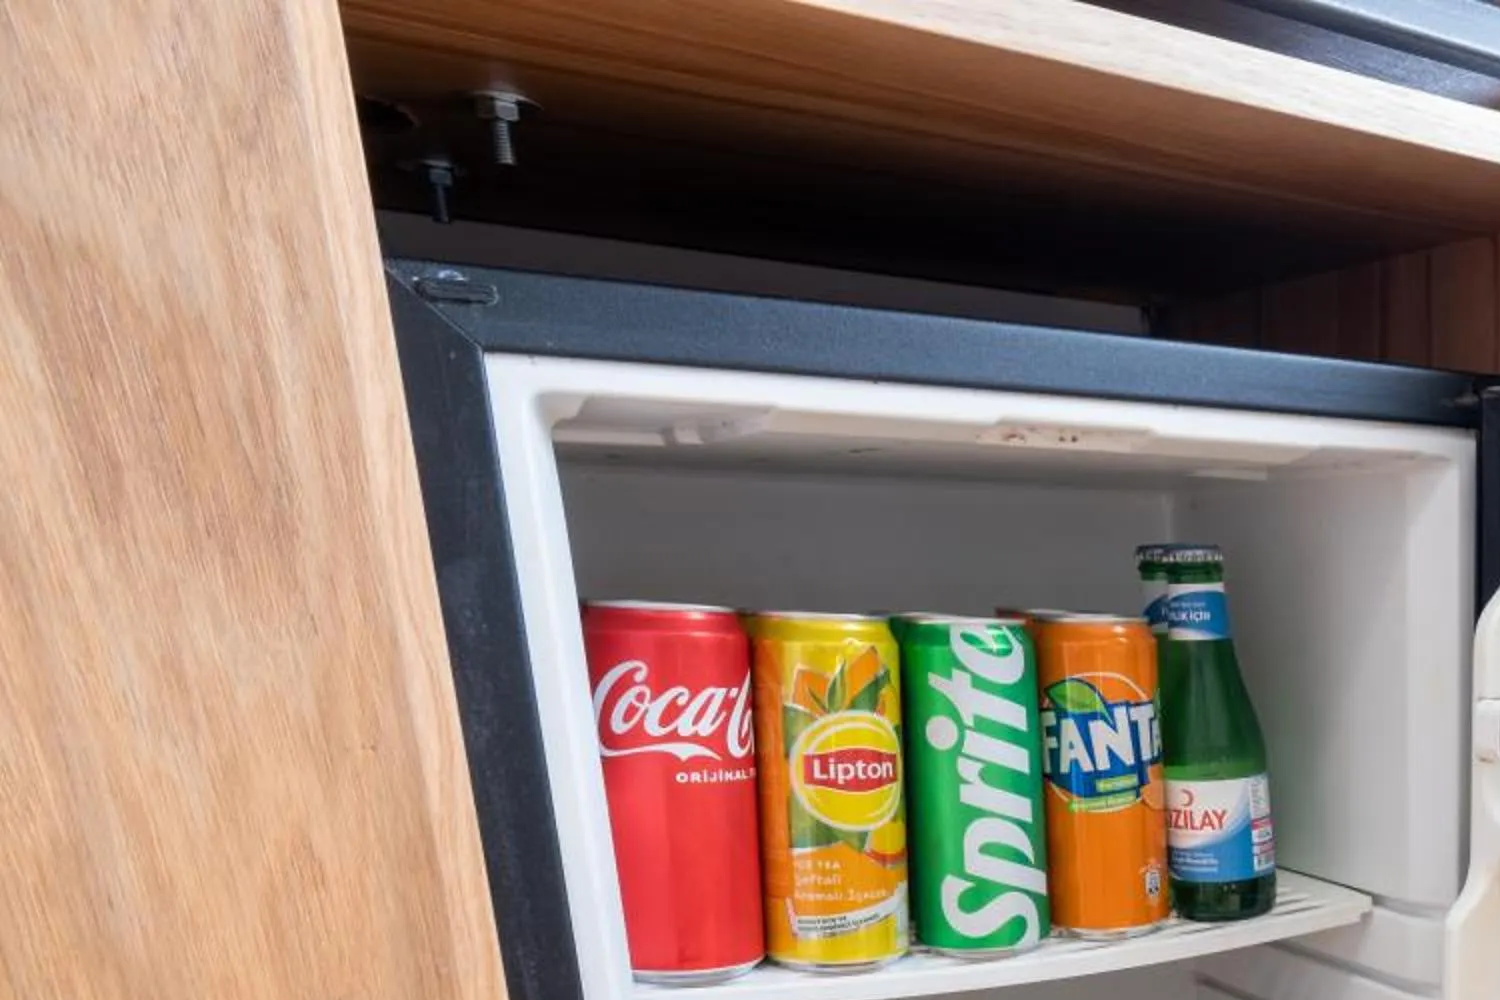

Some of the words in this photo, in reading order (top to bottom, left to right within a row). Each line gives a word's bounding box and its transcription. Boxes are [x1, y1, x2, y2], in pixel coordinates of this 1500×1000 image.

[812, 757, 894, 785] Lipton
[925, 622, 1047, 949] Sprite
[1167, 808, 1227, 832] ZILAY
